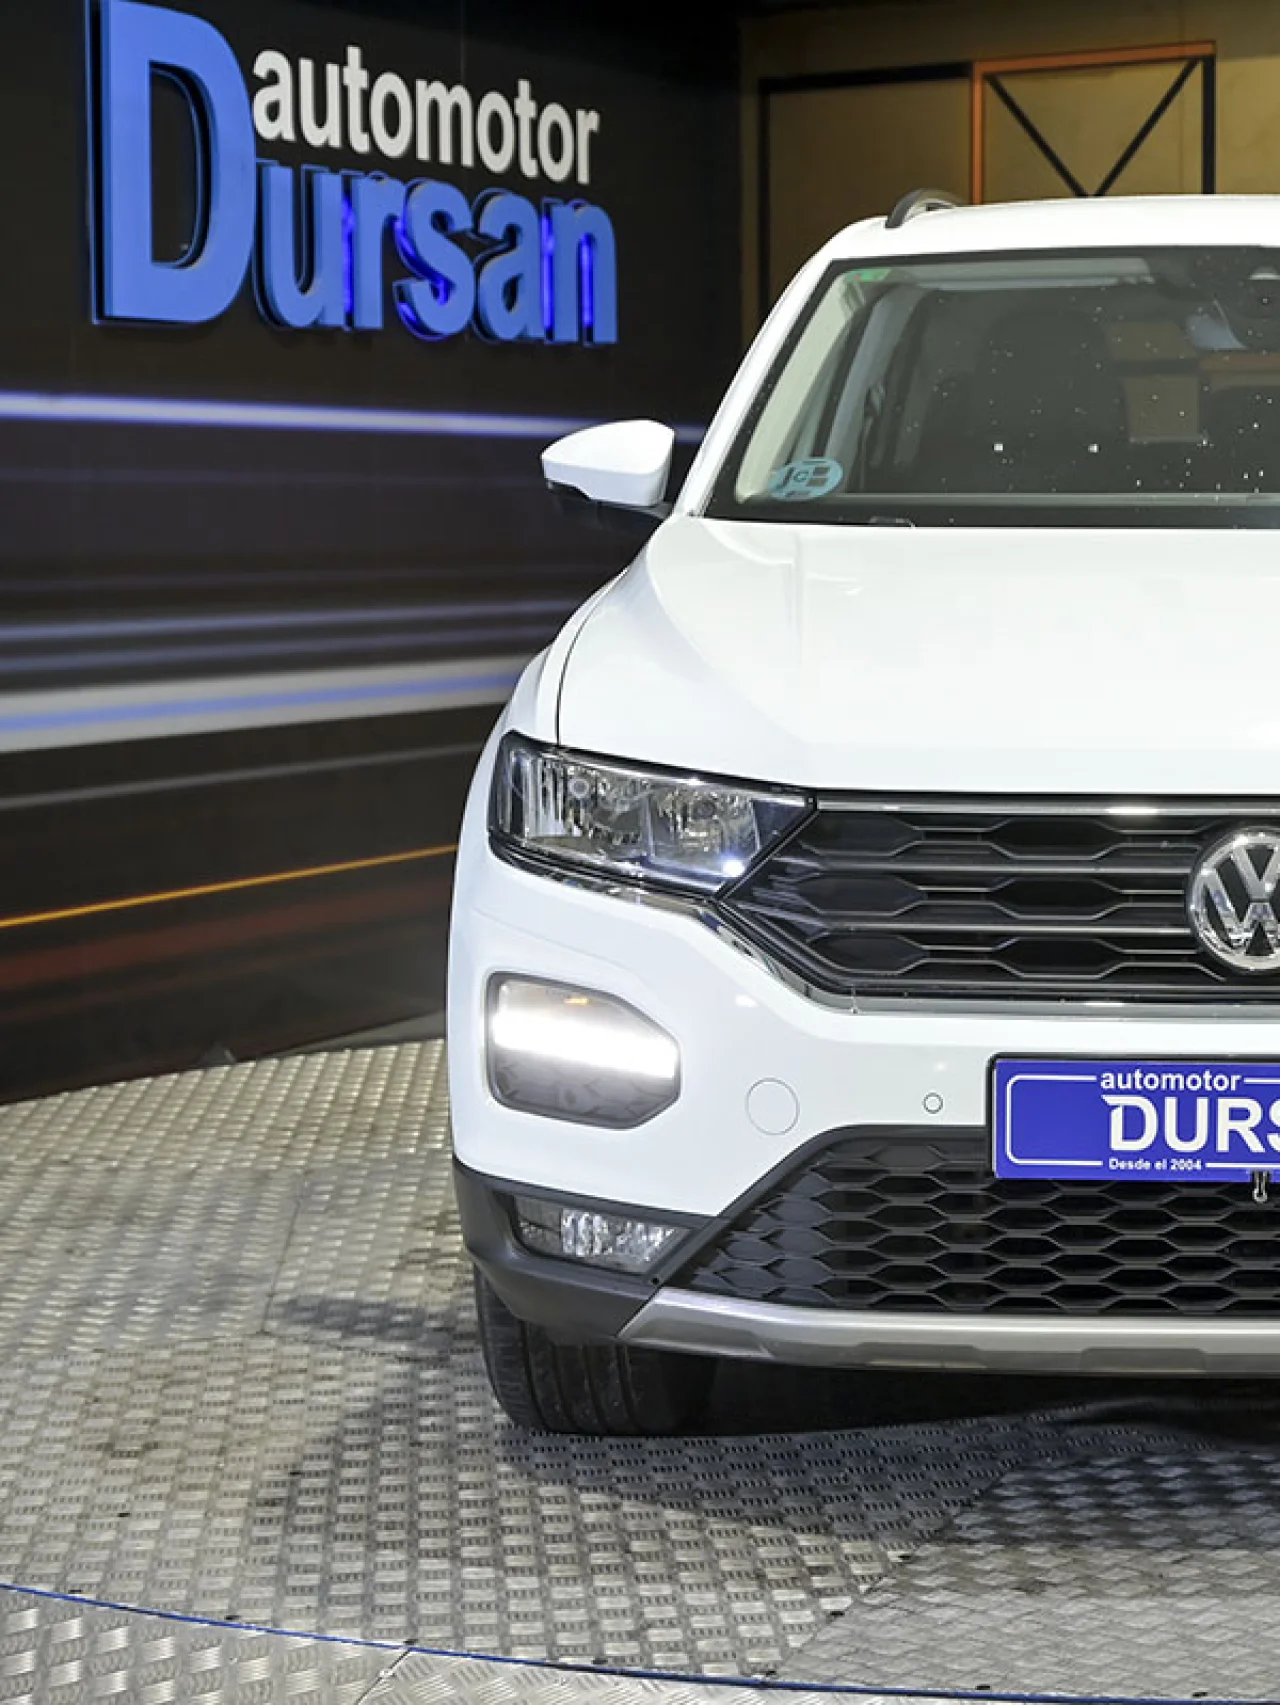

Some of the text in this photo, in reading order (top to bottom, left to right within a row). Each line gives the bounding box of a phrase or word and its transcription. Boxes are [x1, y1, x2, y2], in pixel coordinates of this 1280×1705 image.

[252, 45, 600, 185] automotor
[86, 0, 618, 347] Dursan
[1100, 1068, 1241, 1091] automotor
[1108, 1157, 1202, 1171] Desde el 2004
